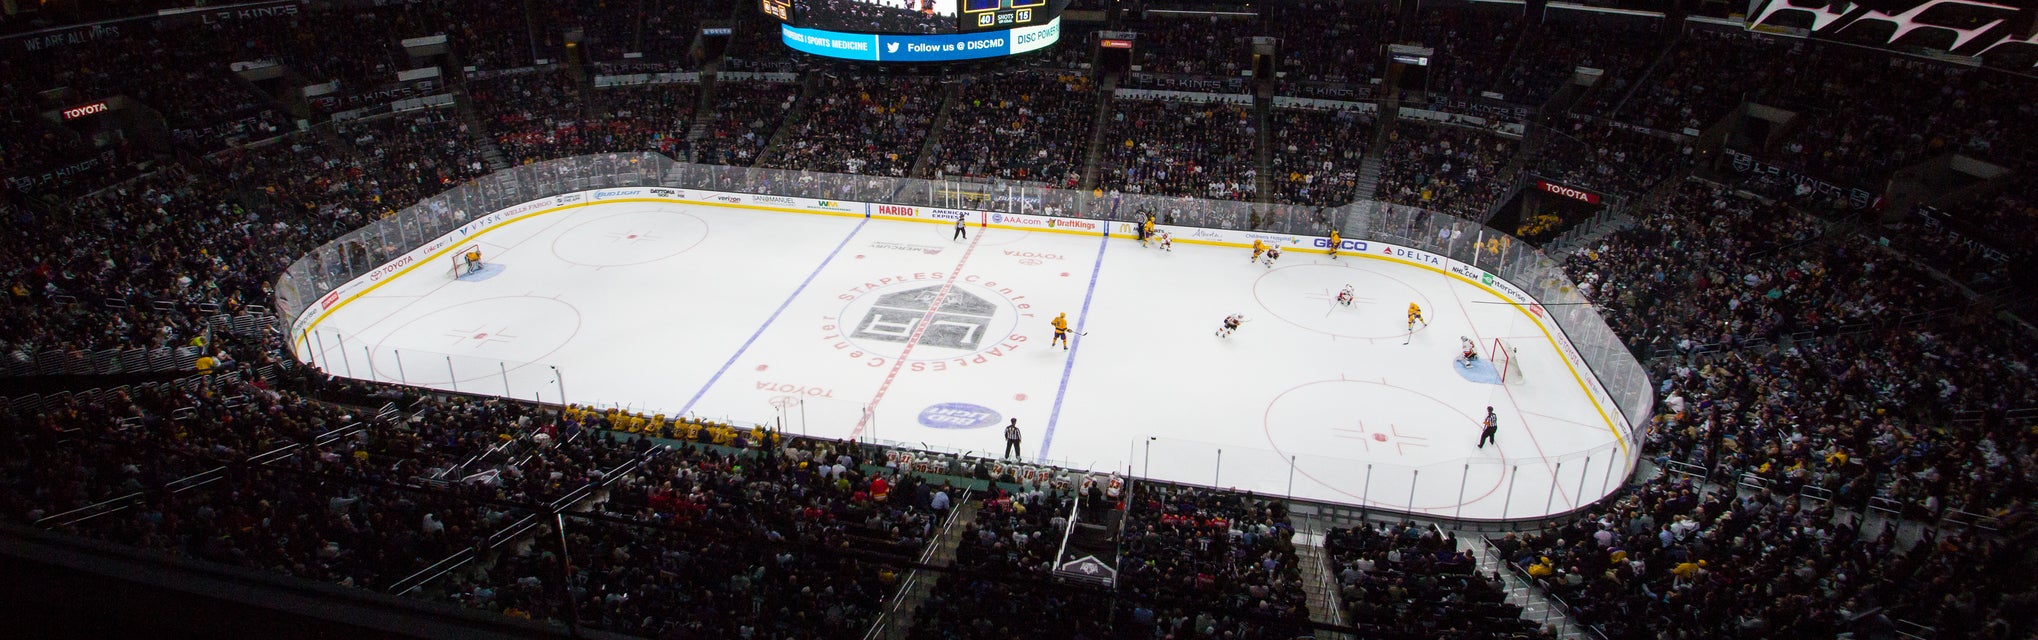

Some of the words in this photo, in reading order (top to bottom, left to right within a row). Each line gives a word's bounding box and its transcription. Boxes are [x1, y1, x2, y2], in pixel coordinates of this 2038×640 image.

[980, 15, 991, 24] 40
[1019, 11, 1029, 20] 15
[808, 36, 831, 48] SPORTS
[831, 40, 868, 51] MEDICINE
[908, 43, 940, 52] Follow
[943, 44, 955, 52] us
[957, 42, 966, 51] @
[967, 38, 1005, 50] DISCMD
[1017, 31, 1037, 45] DISC
[63, 102, 109, 120] TOYOTA
[718, 195, 741, 203] verizon
[1545, 182, 1589, 203] TOYOTA
[879, 205, 913, 217] HARIBO
[932, 209, 970, 217] AMERICAN
[1003, 216, 1042, 226] AAA.com
[1056, 218, 1096, 231] DraftKings
[1003, 249, 1066, 261] TOYOTA
[1397, 248, 1440, 265] DELTA
[382, 254, 414, 275] TOYOTA
[1452, 266, 1479, 281] NHL.COM
[838, 271, 944, 302] STAPLES
[964, 274, 1035, 319] Center
[822, 315, 886, 369] Center
[911, 332, 1028, 373] STAPLES
[756, 380, 834, 399] TOYOTA
[931, 405, 992, 421] LIGHT
